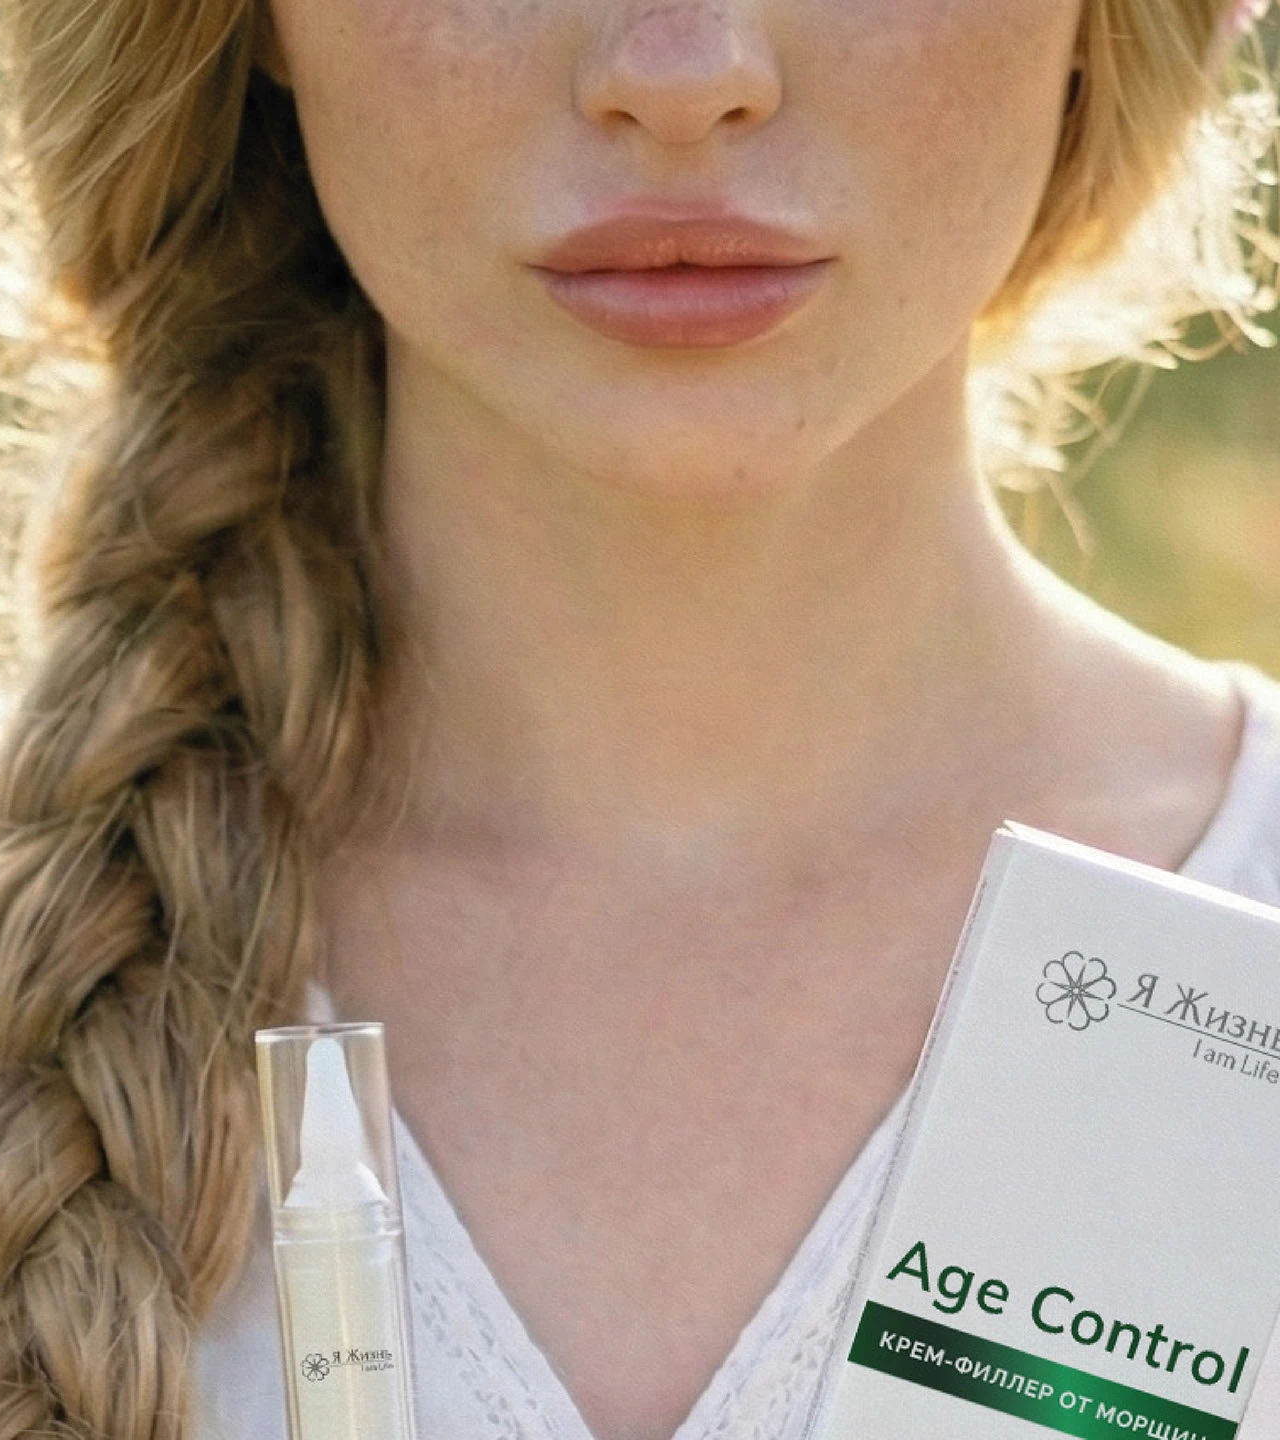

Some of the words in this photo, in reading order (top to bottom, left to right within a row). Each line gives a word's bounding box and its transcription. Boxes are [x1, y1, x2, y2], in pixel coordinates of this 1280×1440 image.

[1125, 973, 1159, 1009] Я
[1192, 1038, 1203, 1059] I
[1203, 1048, 1237, 1071] am
[1239, 1054, 1280, 1085] Life
[885, 1239, 1011, 1316] Age
[1030, 1285, 1253, 1395] Control
[331, 1350, 341, 1364] Я
[878, 1329, 1055, 1401] КРЕМ-ФИЛЛЕР
[1058, 1389, 1094, 1414] ОТ
